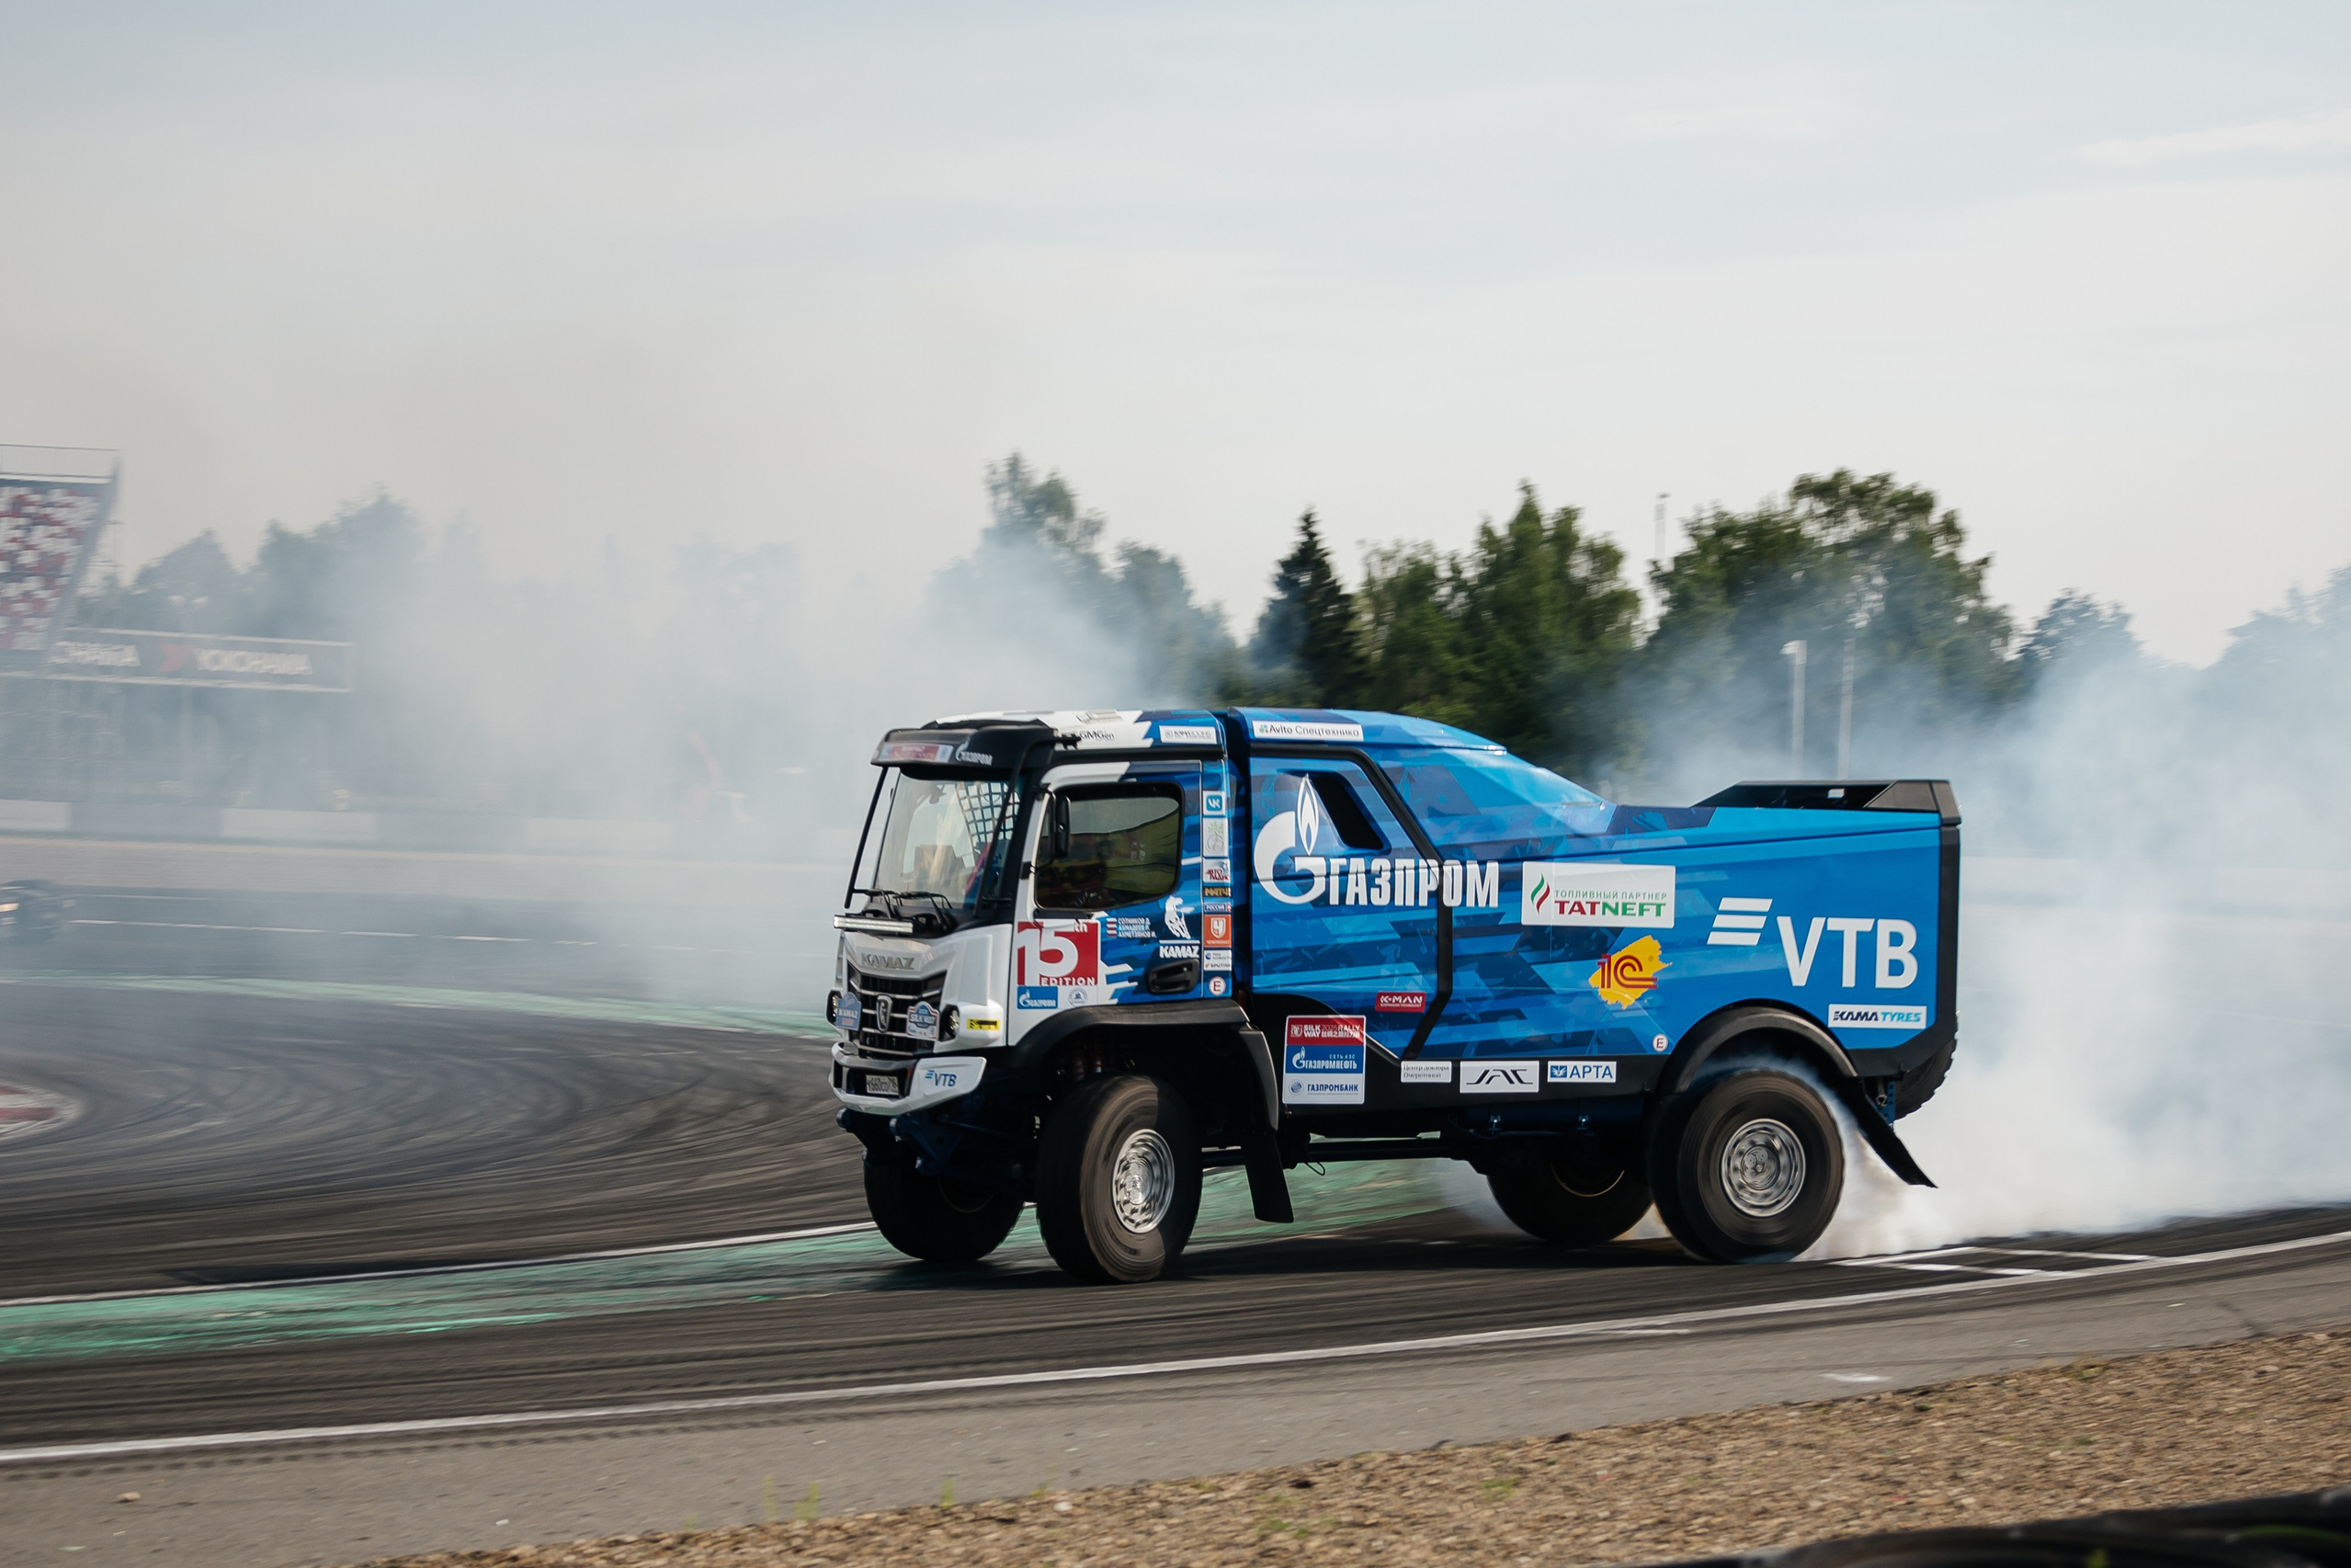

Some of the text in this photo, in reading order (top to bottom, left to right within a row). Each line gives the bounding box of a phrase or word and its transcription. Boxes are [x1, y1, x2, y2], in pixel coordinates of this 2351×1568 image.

[194, 648, 312, 675] YOKOHAMA
[1269, 724, 1359, 737] Avito Спецтехника
[1329, 858, 1499, 907] ГАЗПРОМ
[1555, 890, 1667, 901] ТОПЛИВНЫЙ ПАРТНЕР
[1554, 901, 1666, 917] TATNEFT
[1159, 946, 1200, 959] KAMAZ
[1777, 915, 1918, 989] VTB
[861, 953, 914, 970] KAMAZ
[1040, 977, 1096, 987] EDITION
[1213, 981, 1221, 992] E
[1833, 1010, 1922, 1022] KAMA TYRES
[1305, 1060, 1357, 1070] ГАЗПРОМНЕФТЬ
[934, 1074, 958, 1086] VTB
[1307, 1084, 1358, 1092] ГАЗПРОМБАНК
